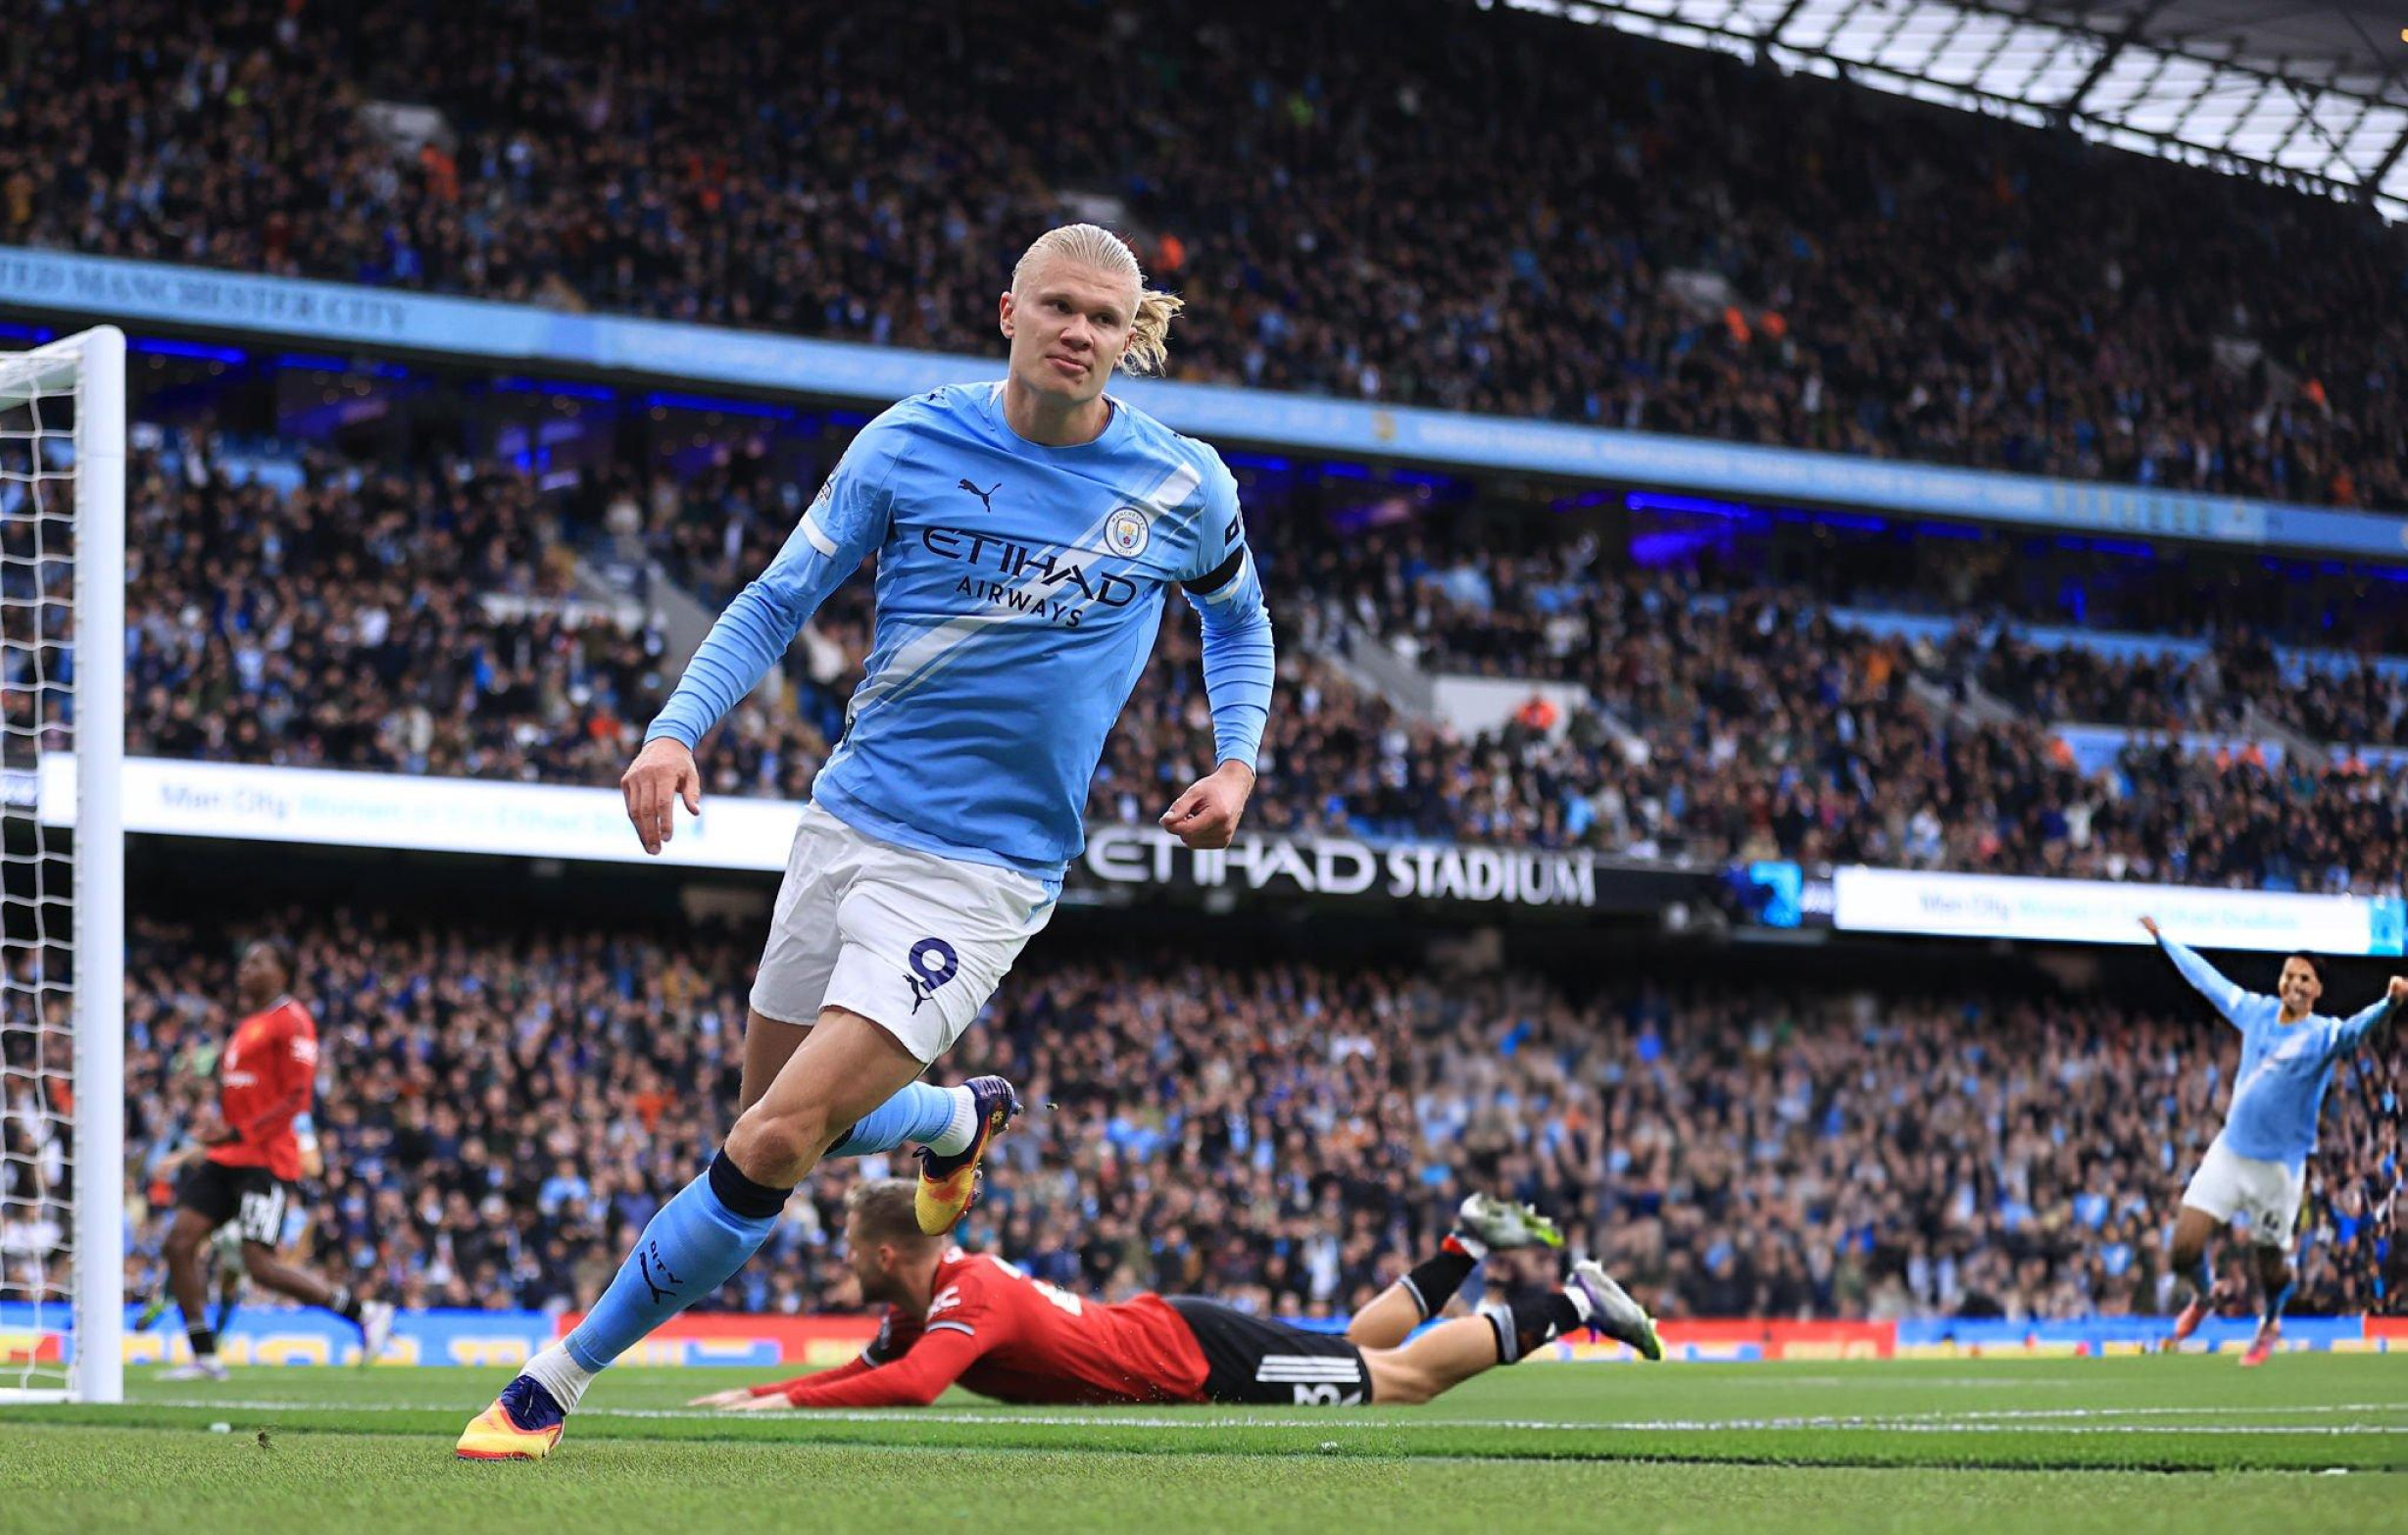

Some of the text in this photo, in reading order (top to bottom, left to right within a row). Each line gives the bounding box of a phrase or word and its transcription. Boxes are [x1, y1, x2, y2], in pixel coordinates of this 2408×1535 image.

[922, 526, 1137, 607] ETIHAD
[956, 574, 1083, 628] AIRWAYS
[1085, 824, 1596, 907] ETIHAD STADIUM
[909, 937, 958, 993] 9
